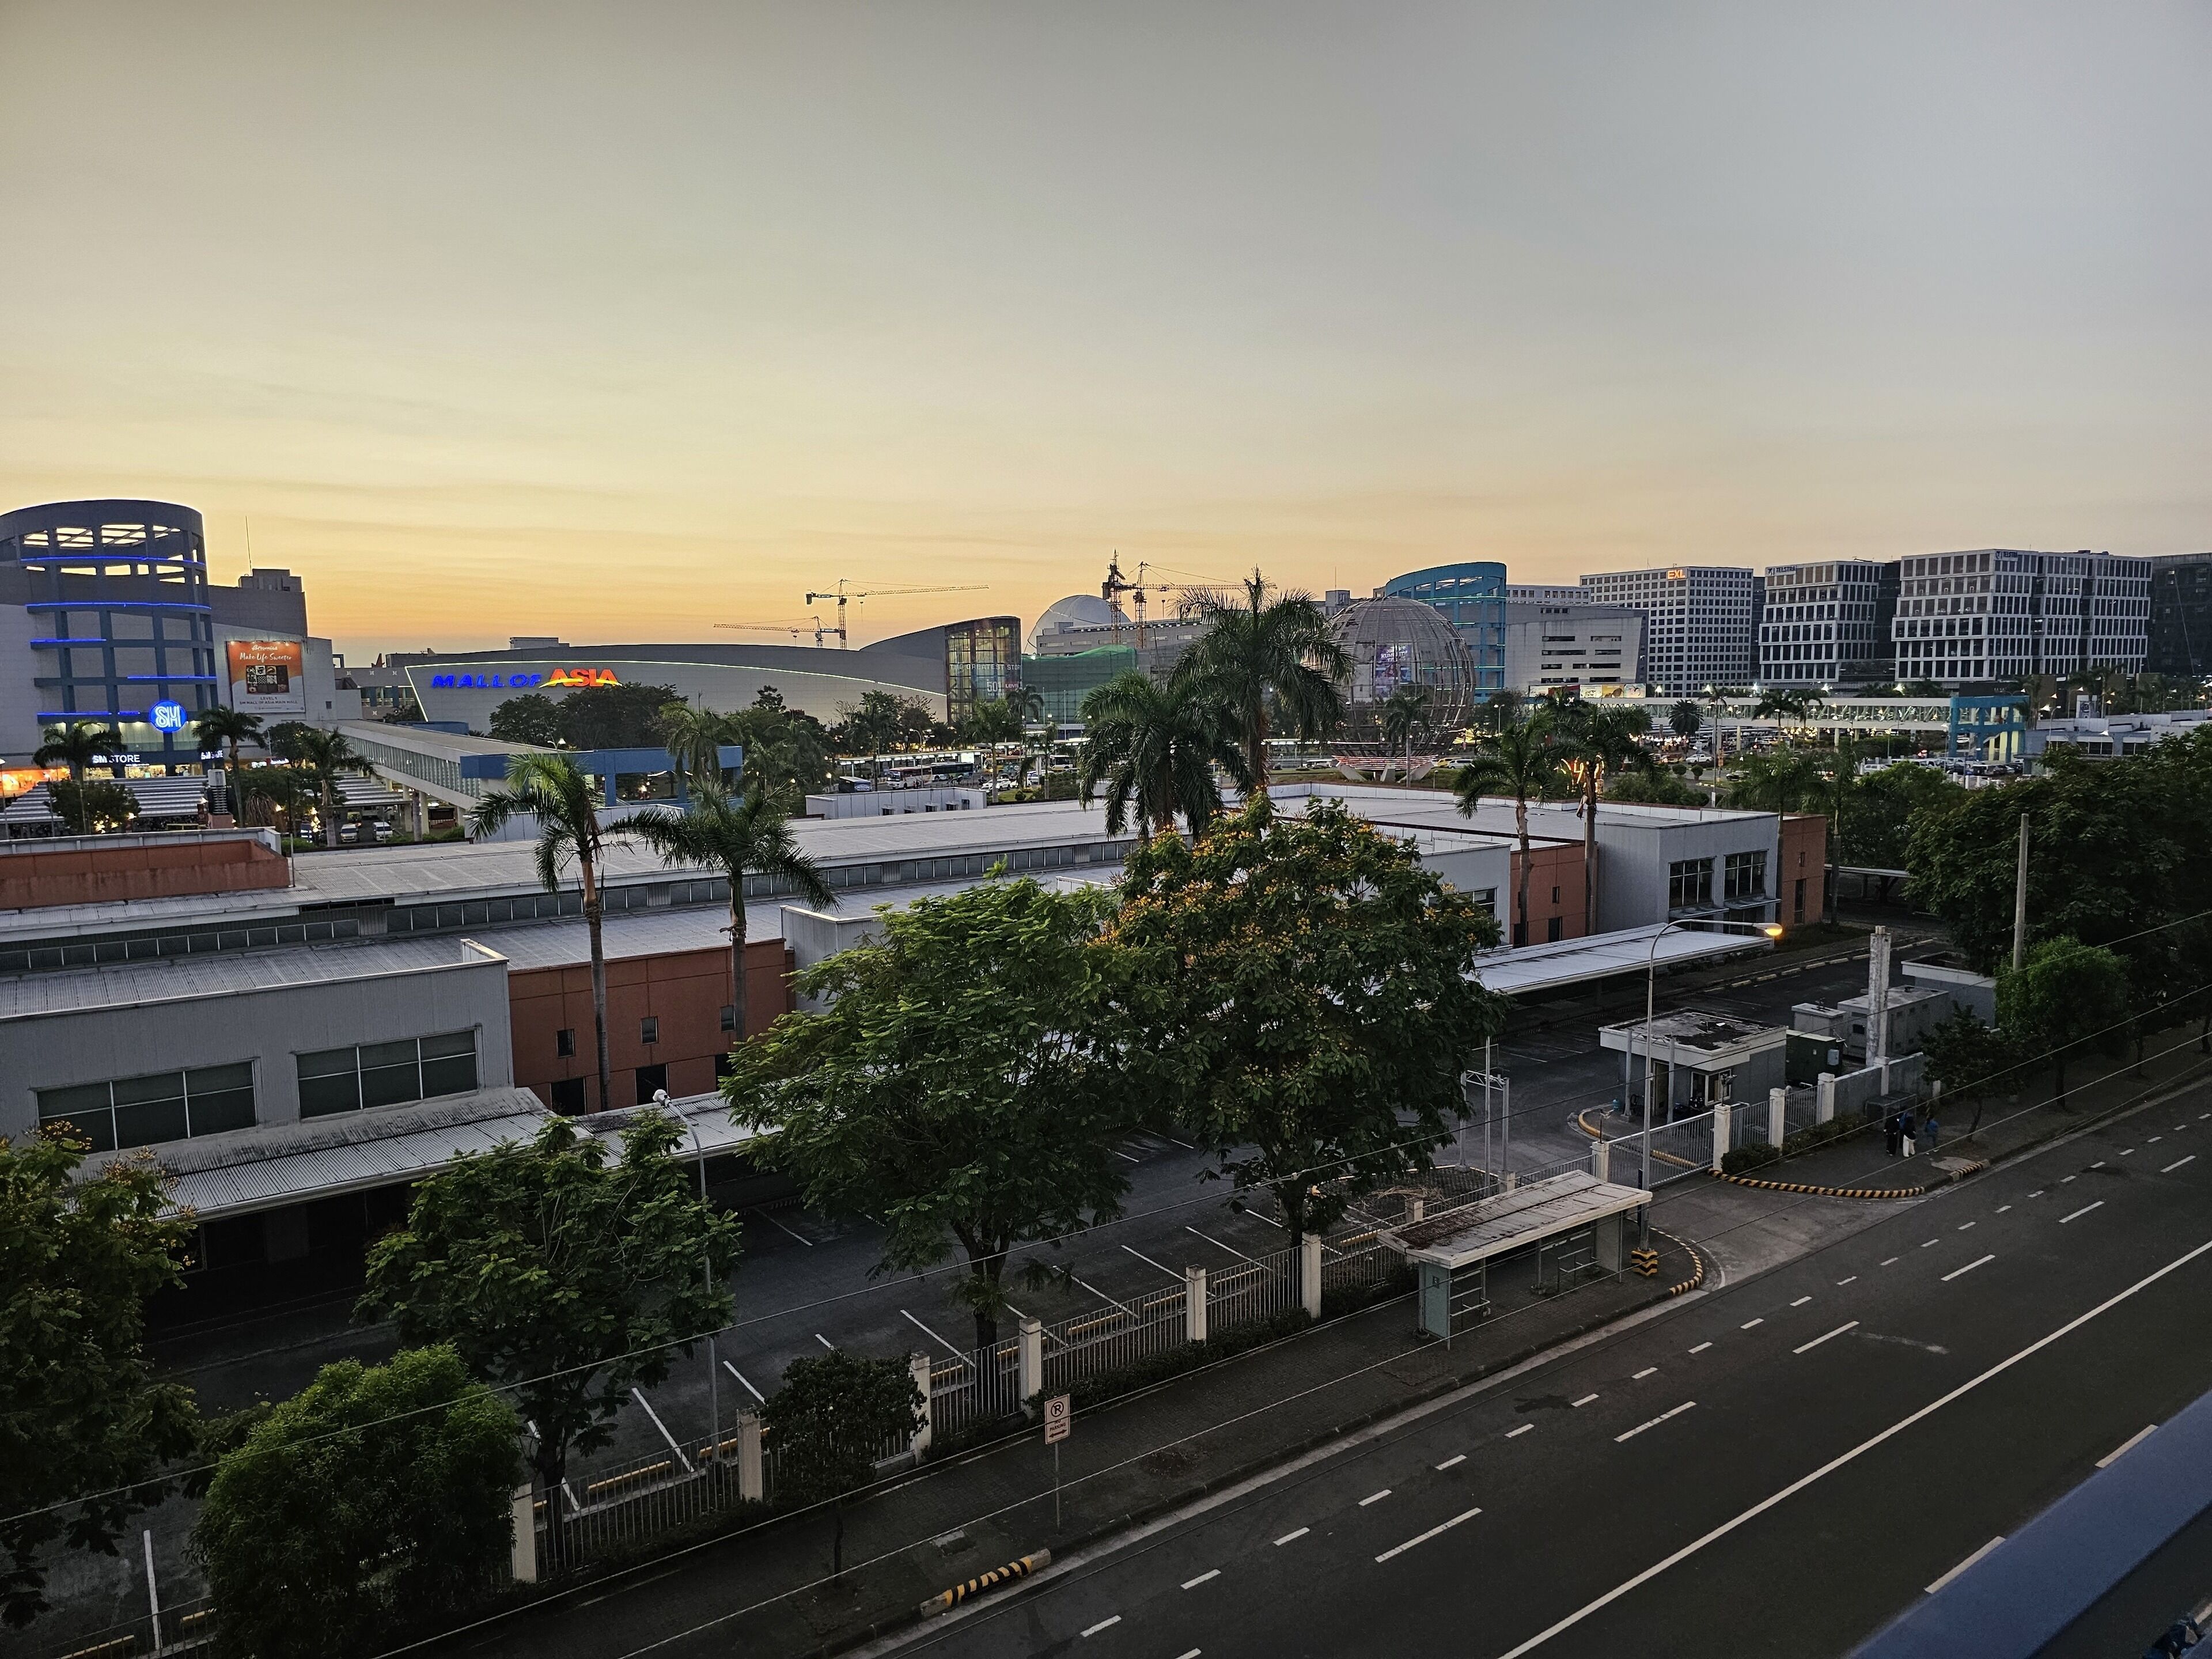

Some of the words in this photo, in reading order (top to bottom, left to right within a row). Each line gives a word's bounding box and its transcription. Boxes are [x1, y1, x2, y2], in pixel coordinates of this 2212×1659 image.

[1667, 569, 1685, 579] EXL
[256, 653, 268, 663] Life
[270, 653, 292, 661] Sweeter
[432, 673, 505, 688] MALL
[509, 673, 542, 688] OF
[549, 668, 619, 688] ASIA
[155, 706, 181, 728] SM
[92, 755, 108, 764] SM
[1050, 1422, 1066, 1432] PARKING
